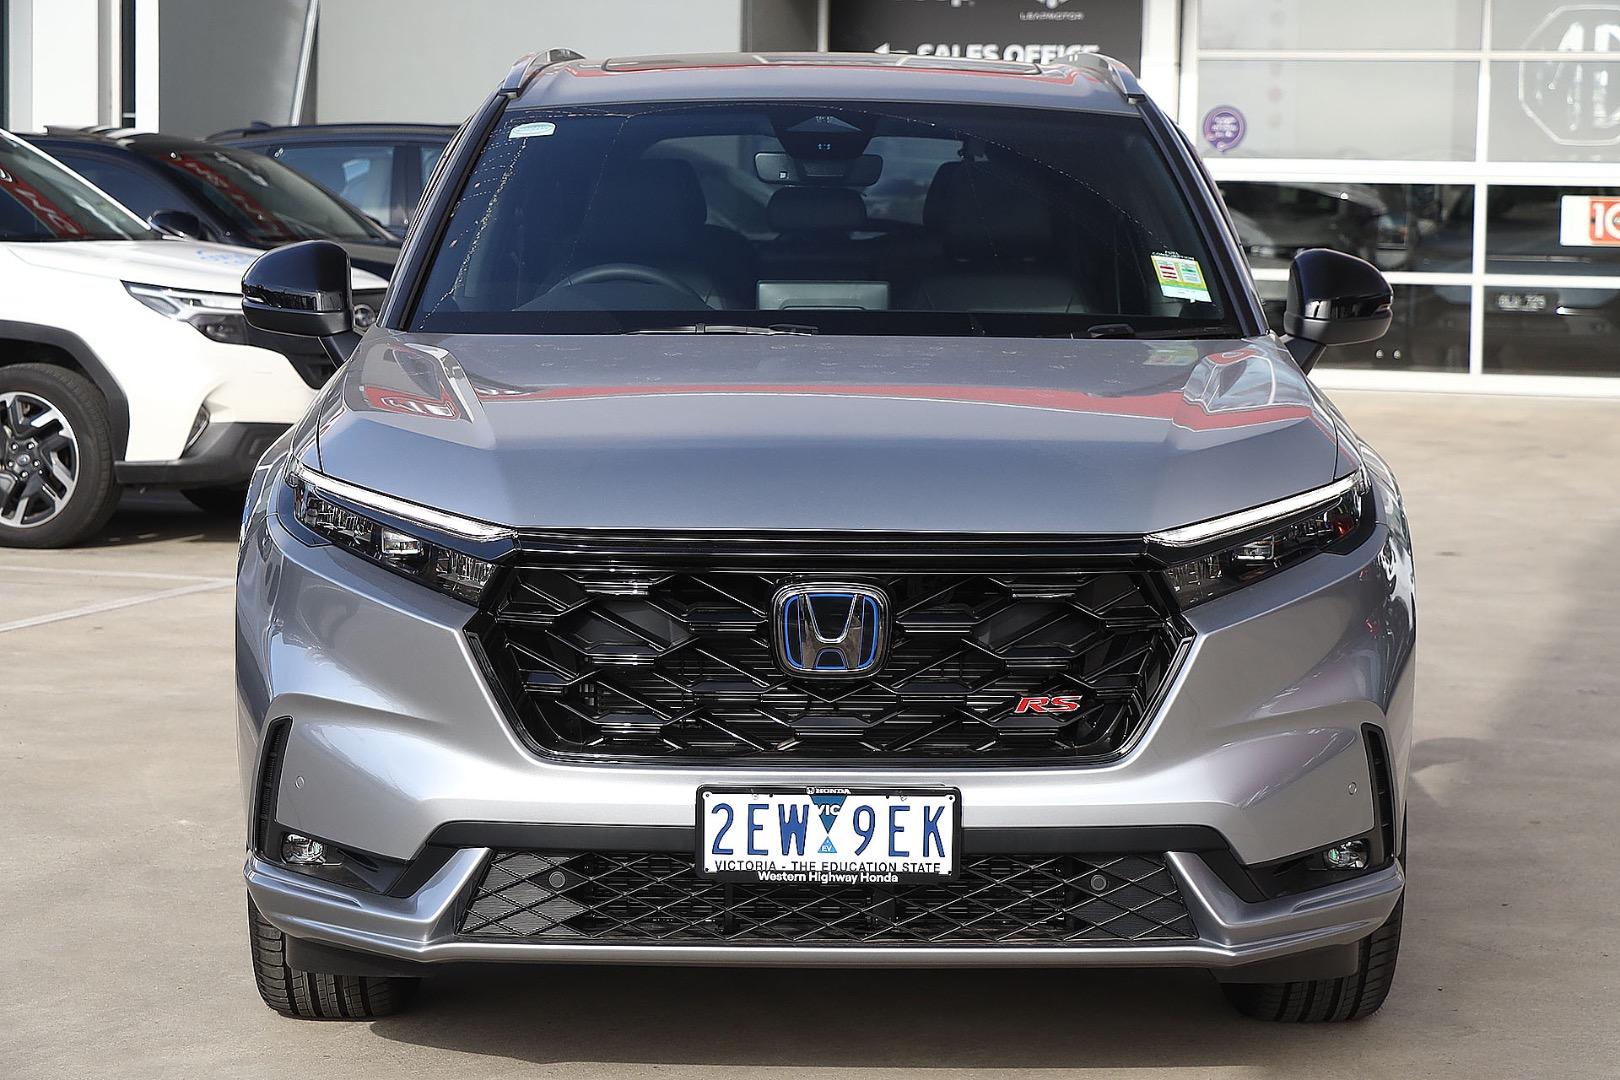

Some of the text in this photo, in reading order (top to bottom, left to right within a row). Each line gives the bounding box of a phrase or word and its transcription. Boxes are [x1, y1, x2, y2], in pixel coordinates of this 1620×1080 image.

[1014, 695, 1083, 714] RS
[815, 804, 841, 816] VIC
[711, 802, 946, 858] 2EW 9EK
[715, 860, 777, 871] VICTORIA
[791, 861, 817, 871] THE
[821, 861, 897, 872] EDUCATION
[901, 862, 941, 873] STATE
[757, 871, 899, 885] Western Highway Honda
